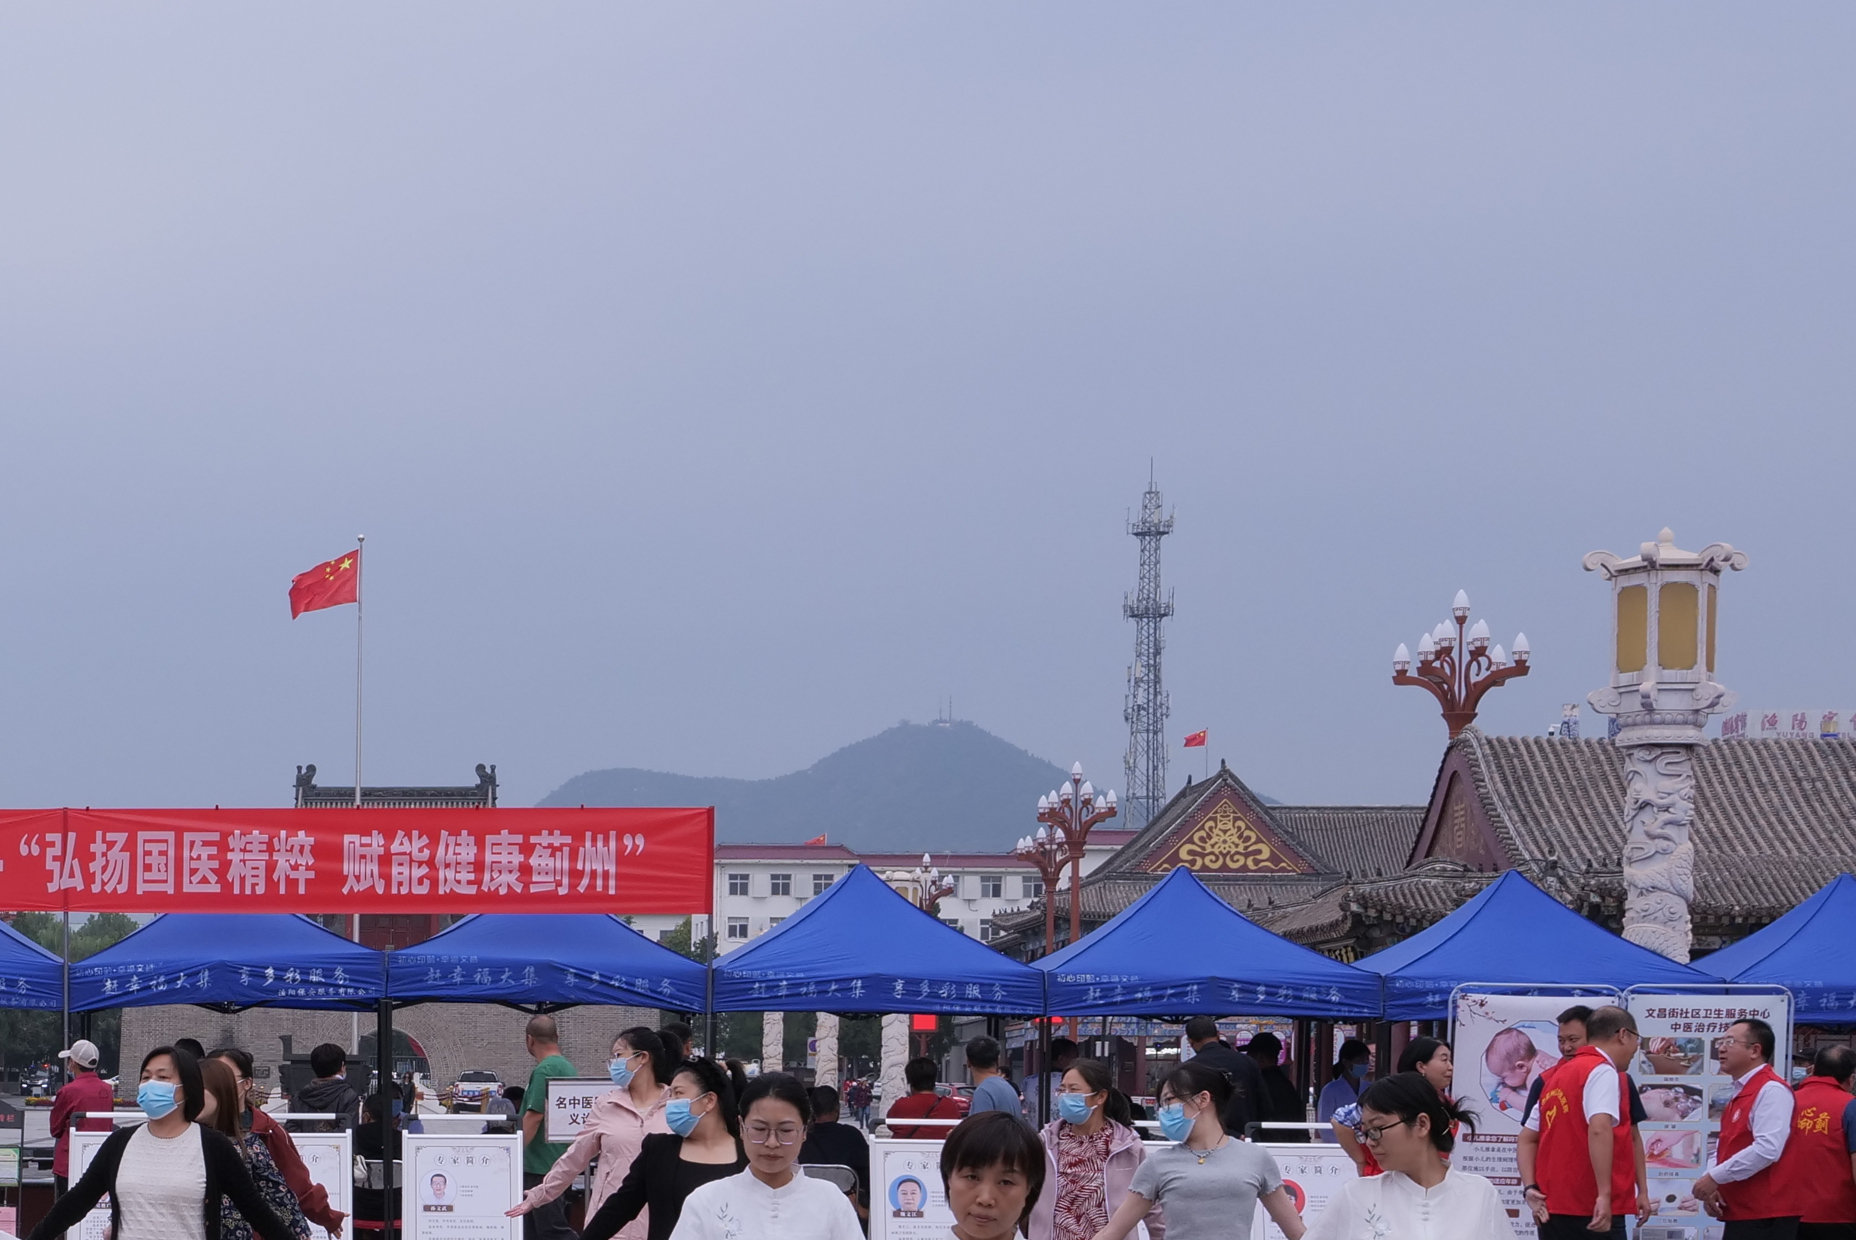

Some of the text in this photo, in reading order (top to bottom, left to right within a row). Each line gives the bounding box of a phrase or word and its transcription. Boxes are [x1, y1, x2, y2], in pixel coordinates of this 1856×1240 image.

[101, 966, 350, 995] 赶幸福大集 享多彩服务
[424, 965, 677, 997] 赶幸福大集 享多彩服务
[749, 978, 1008, 1001] 赶幸福大集 享多彩服务
[1082, 983, 1342, 1004] 赶幸福大集 享多彩服务
[1645, 1008, 1771, 1019] 文昌街社区卫生服务中心
[1670, 1022, 1730, 1033] 中医治疗技
[555, 1096, 599, 1109] 名中医
[436, 1155, 490, 1165] 专家简介
[1284, 1165, 1338, 1175] 专家简介
